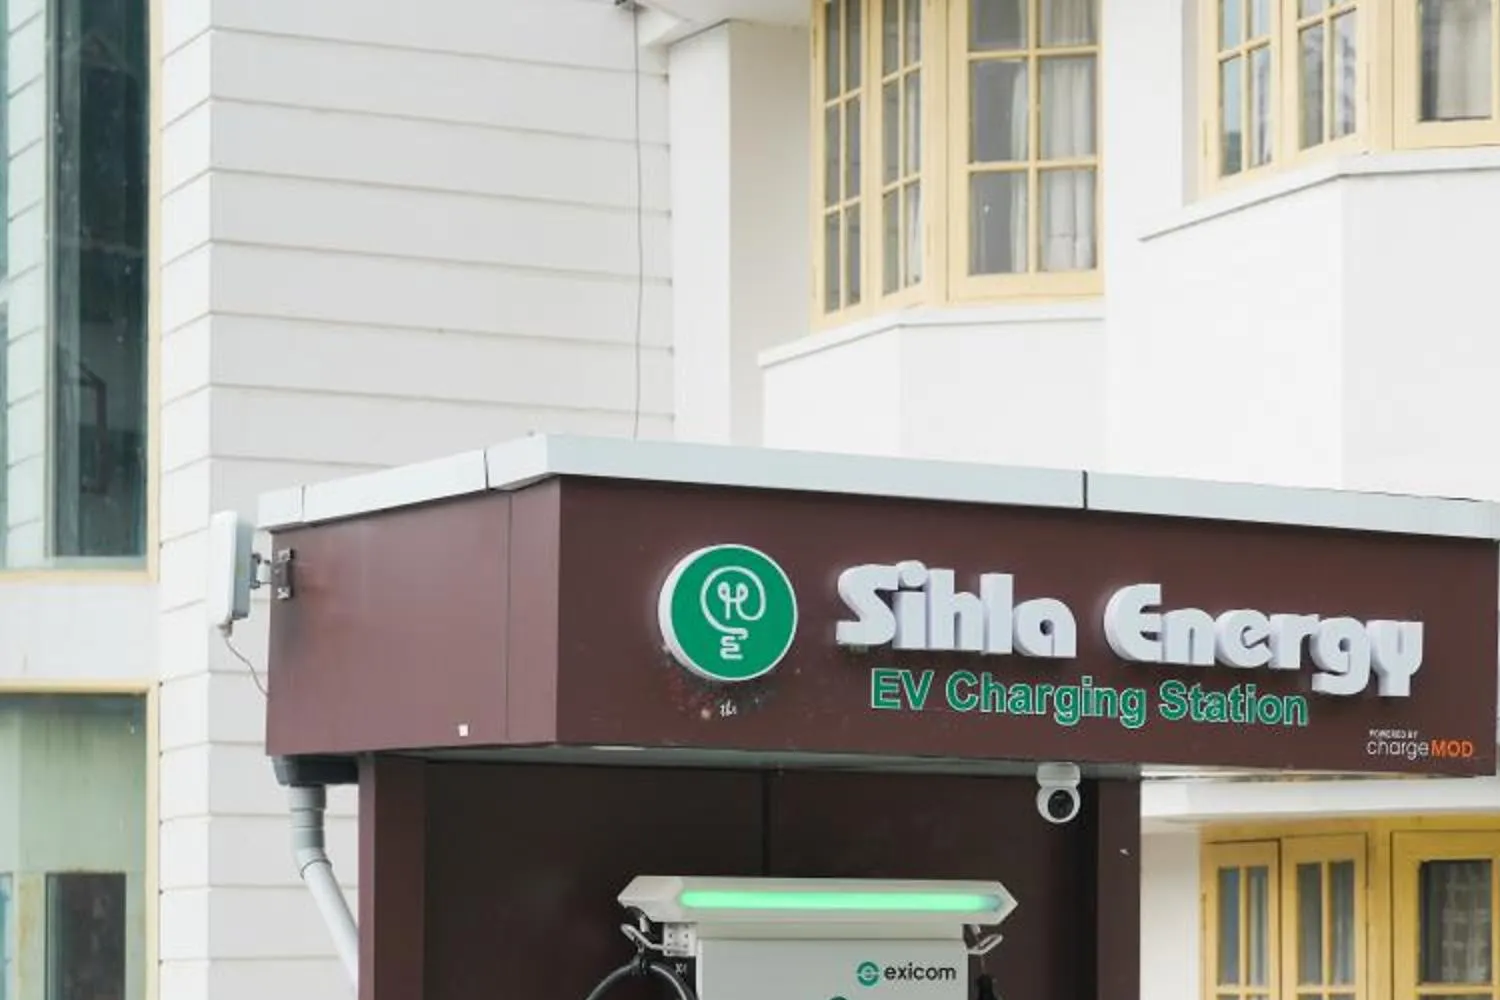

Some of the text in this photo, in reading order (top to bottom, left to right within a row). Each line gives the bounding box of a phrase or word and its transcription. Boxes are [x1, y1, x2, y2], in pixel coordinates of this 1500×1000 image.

[836, 560, 1424, 697] Sihla Energy
[871, 667, 1308, 729] EV Charging Station
[884, 962, 957, 981] exicom
